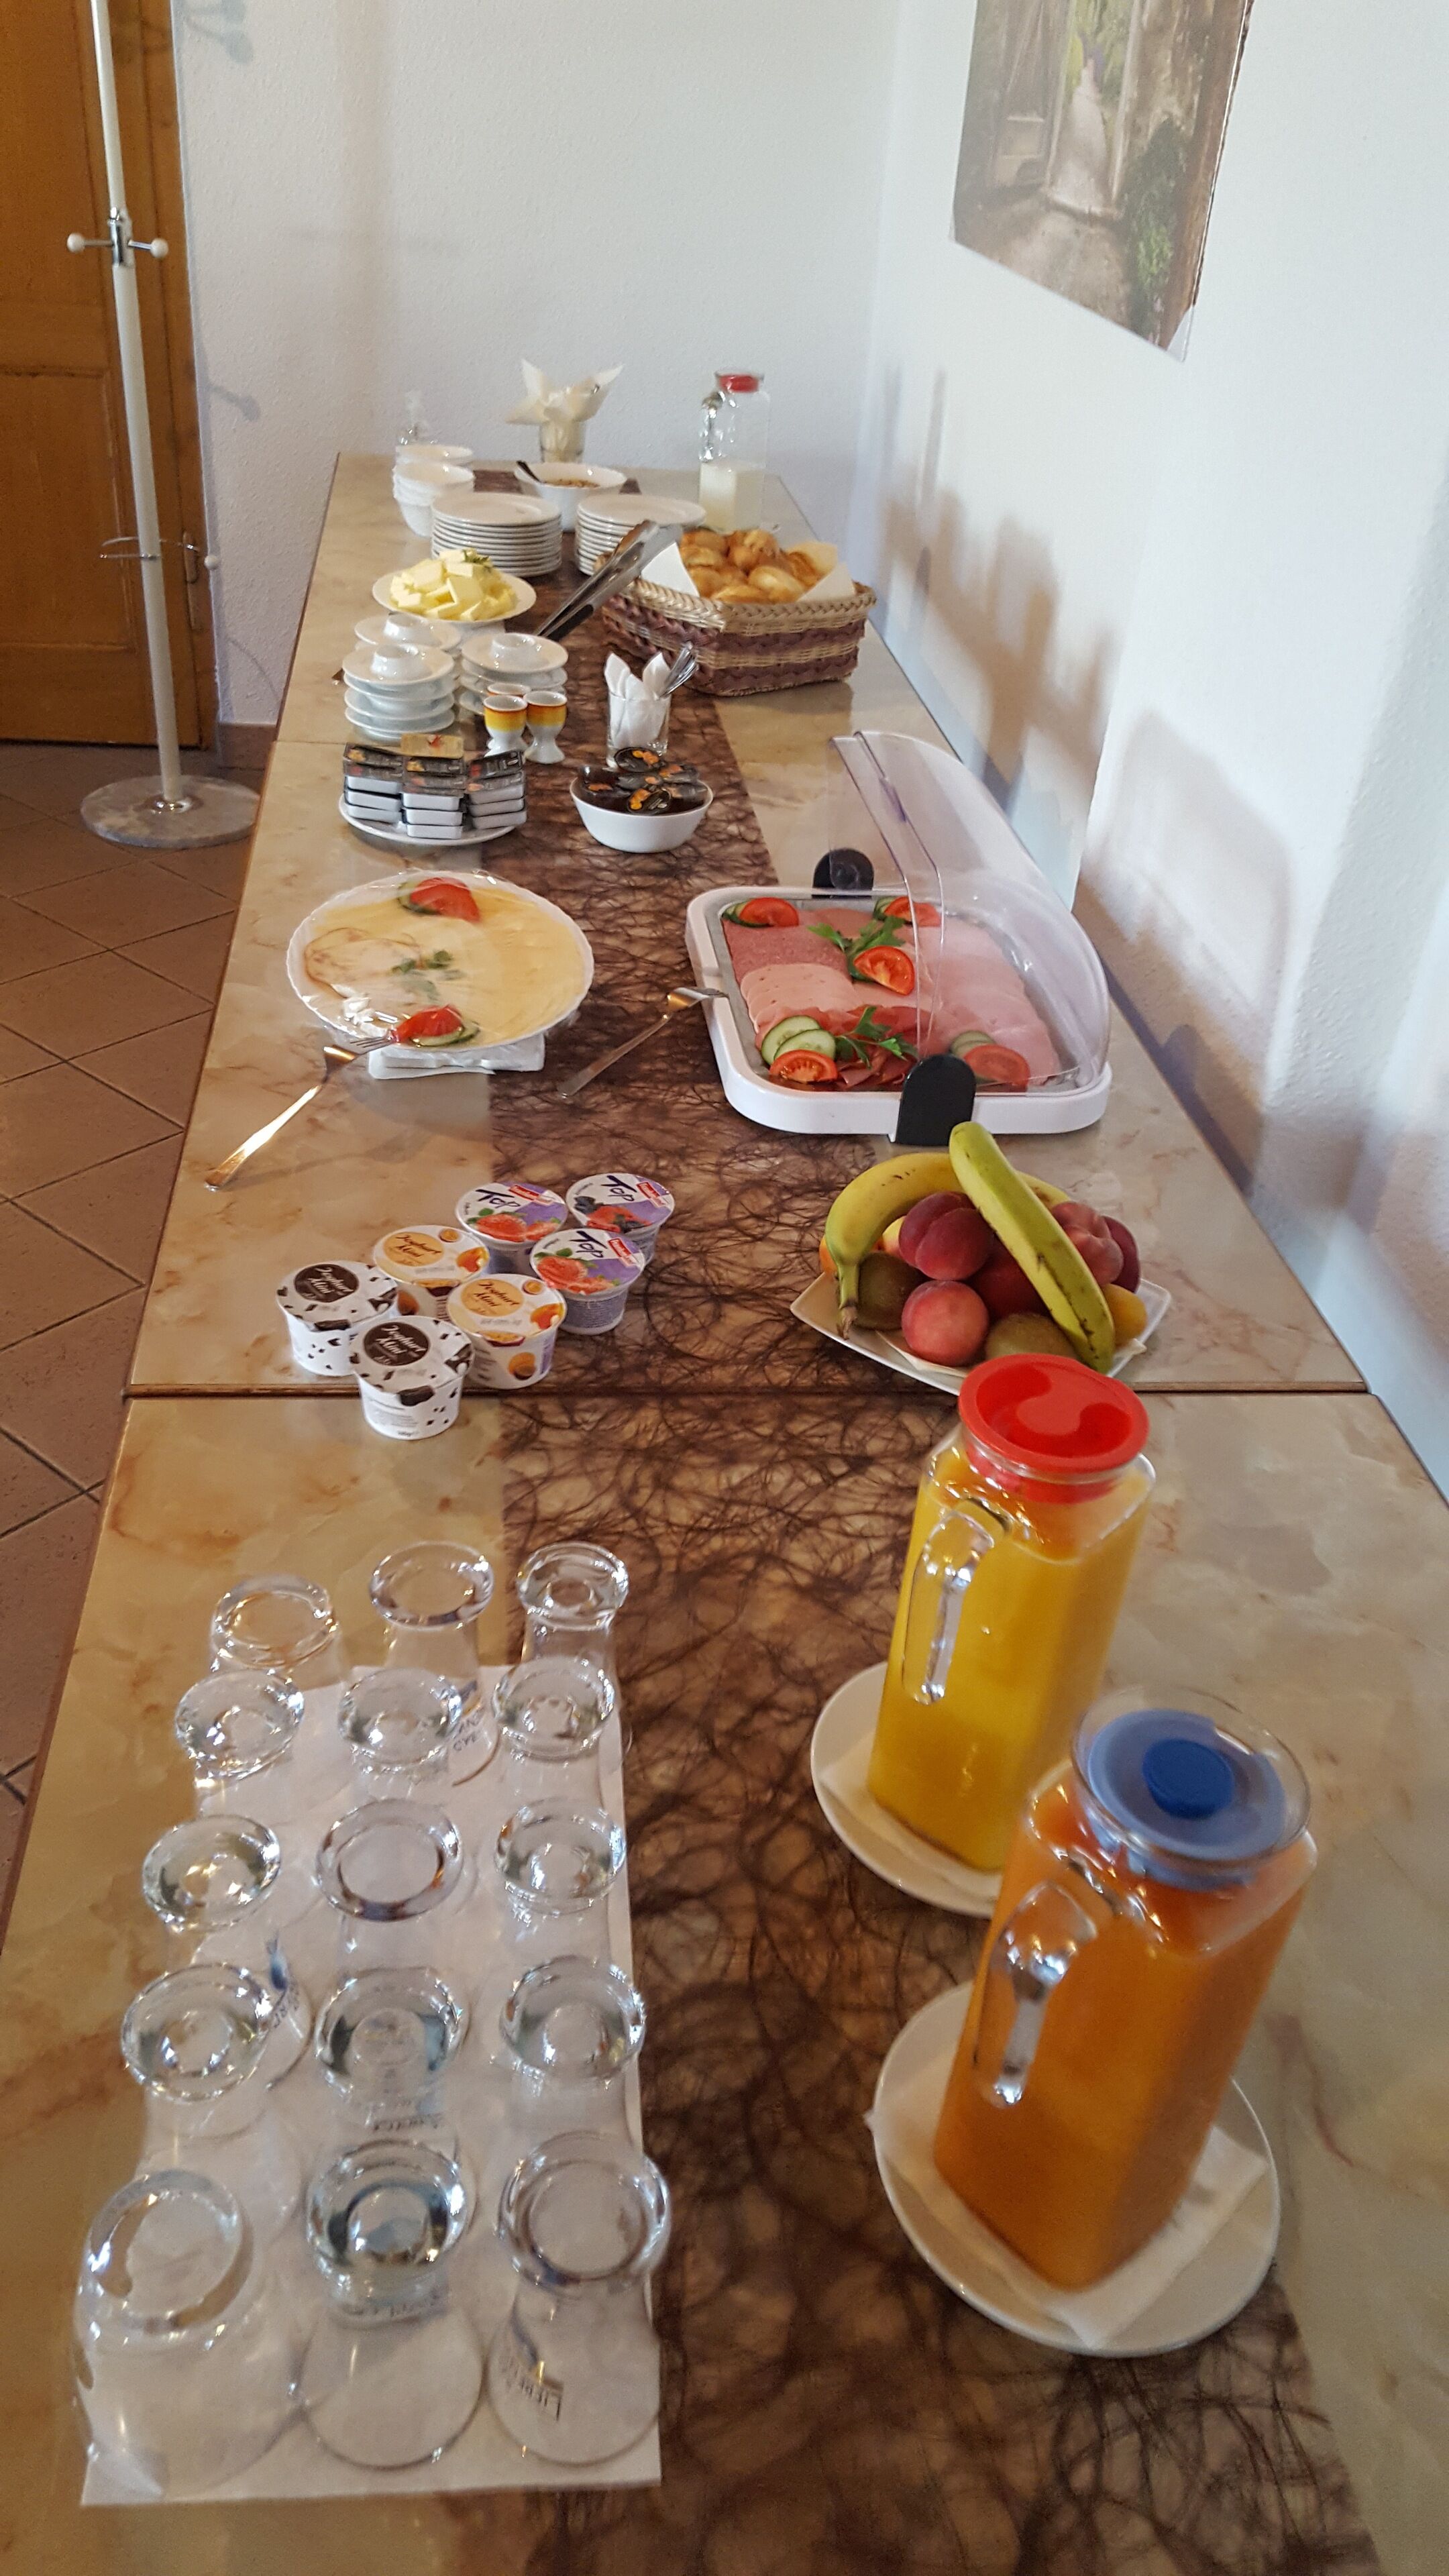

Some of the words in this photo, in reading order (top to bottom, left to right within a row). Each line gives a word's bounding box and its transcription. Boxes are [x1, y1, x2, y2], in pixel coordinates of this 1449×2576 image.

[475, 1189, 521, 1208] Top
[601, 1175, 637, 1202] Top
[569, 1230, 608, 1258] Top
[478, 1281, 520, 1305] Joghurt
[380, 1325, 426, 1352] Joghurt
